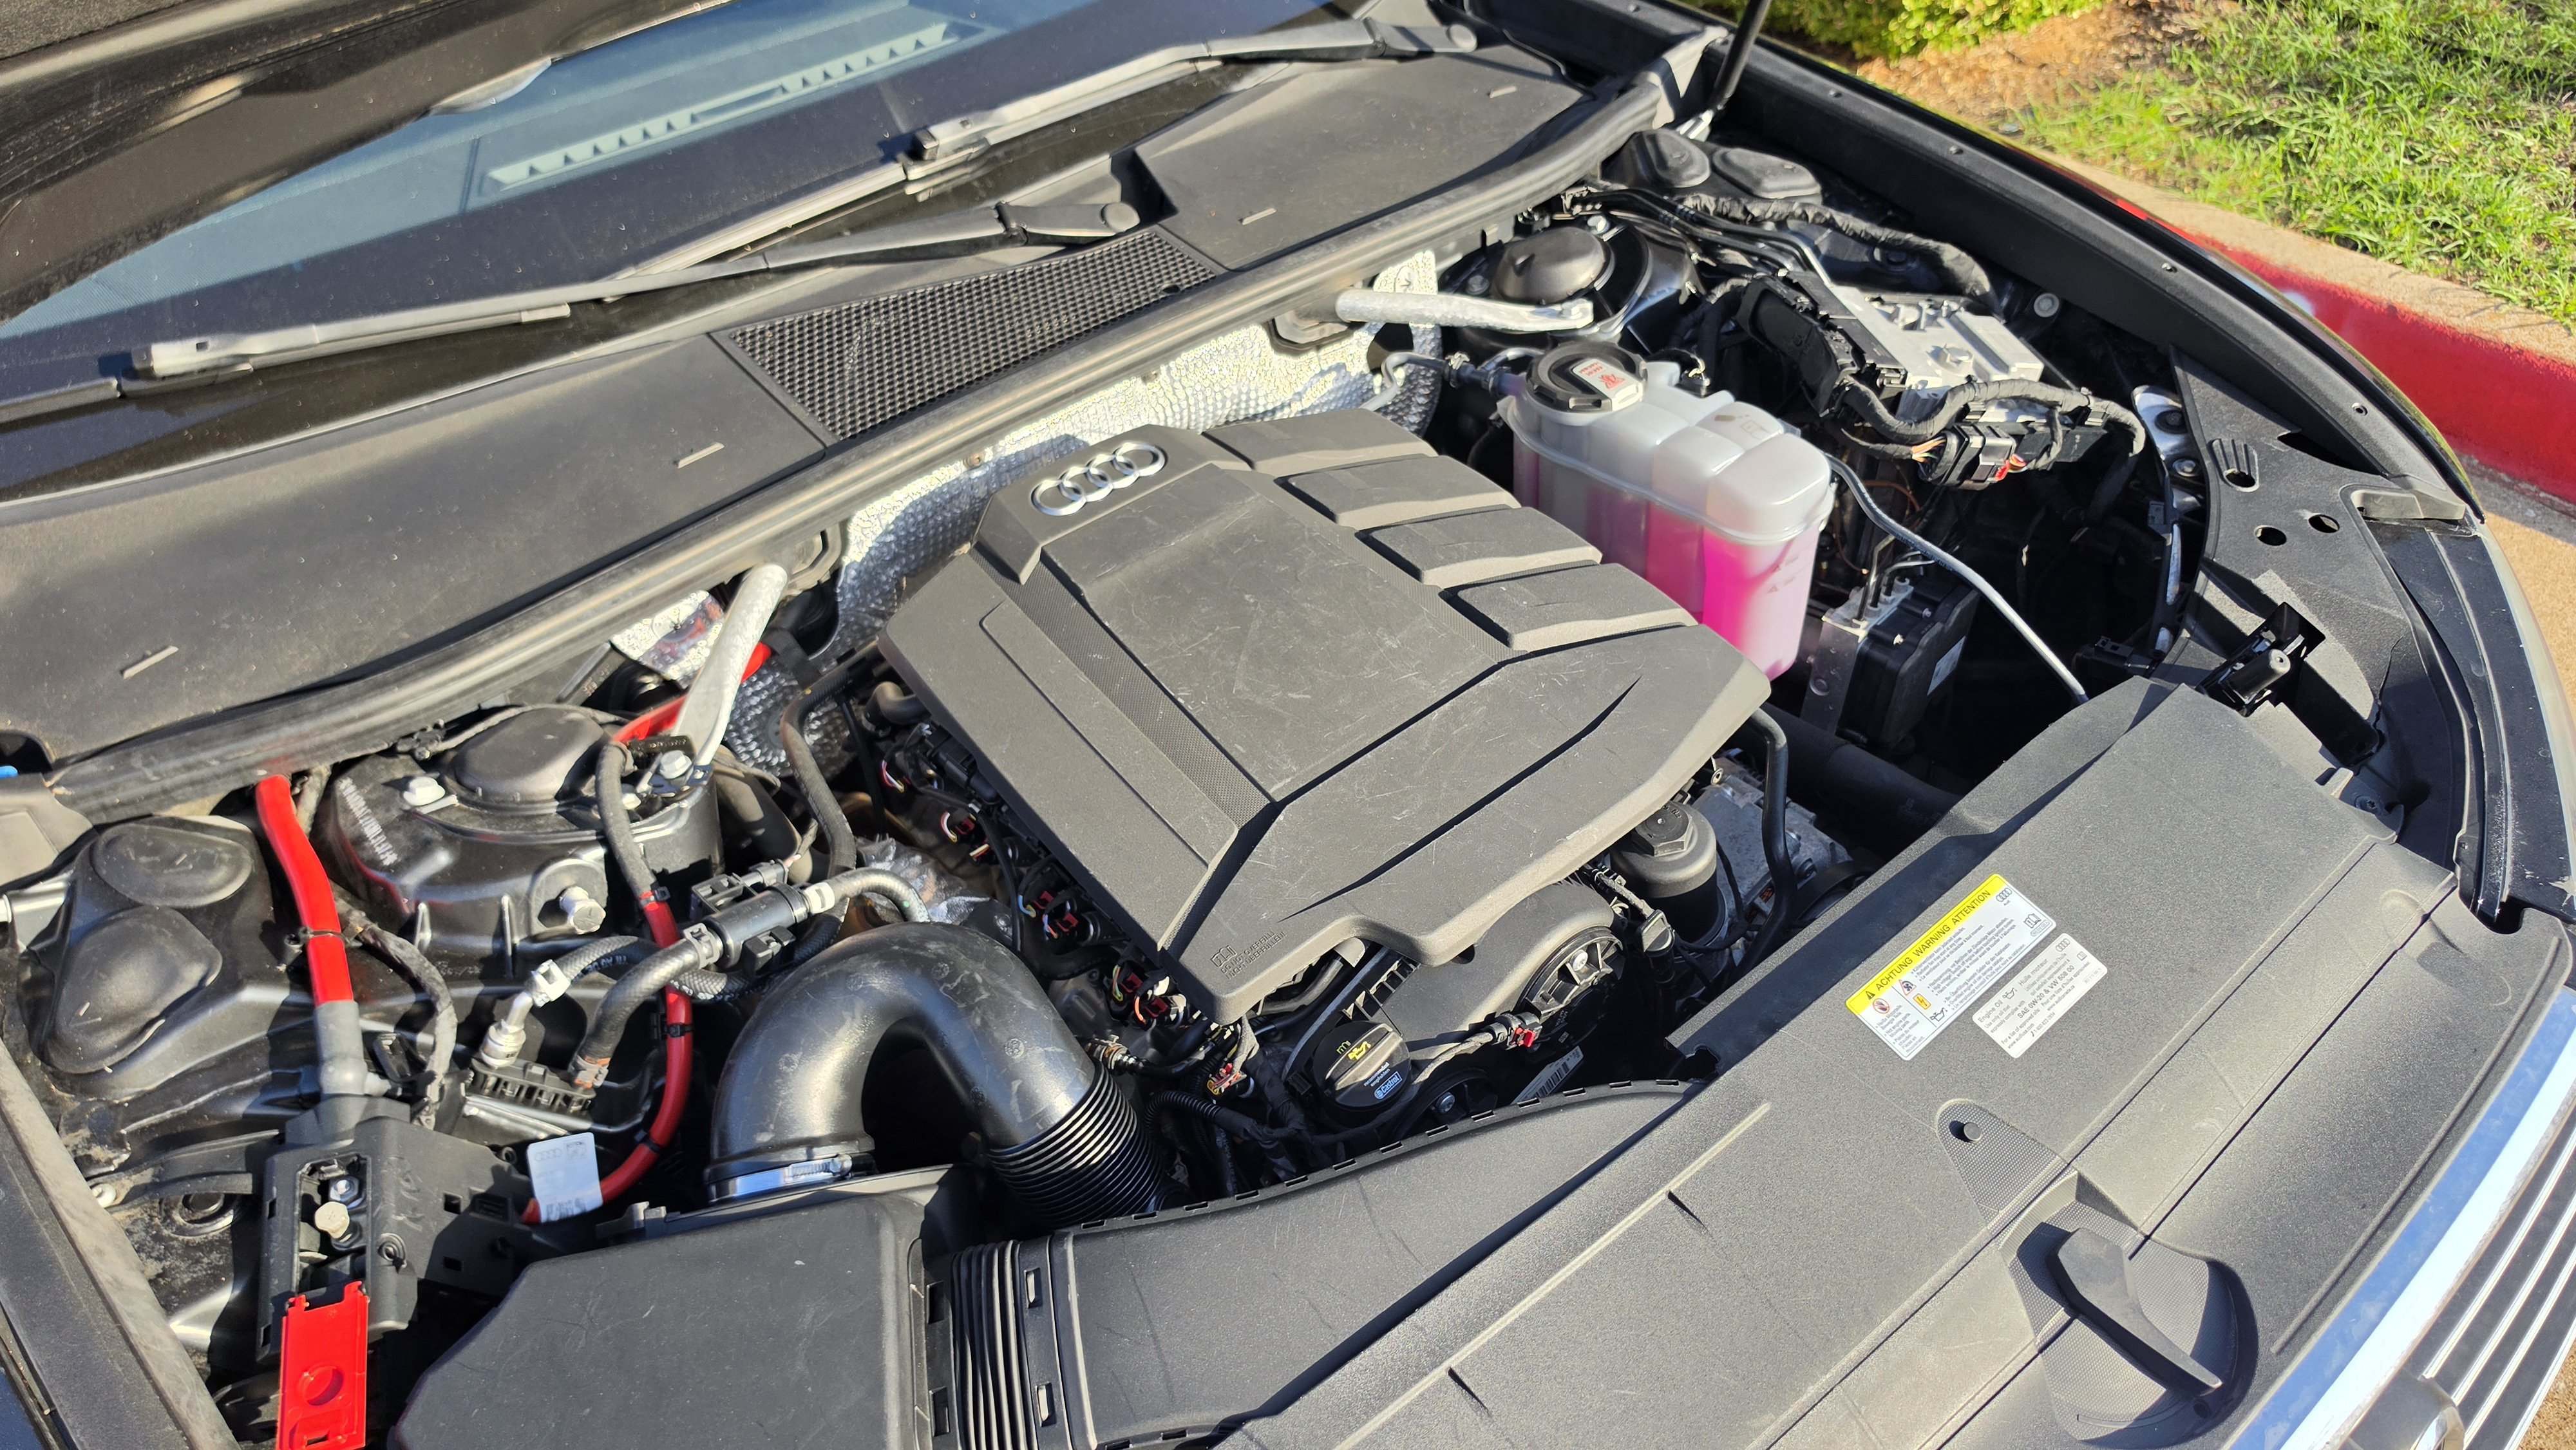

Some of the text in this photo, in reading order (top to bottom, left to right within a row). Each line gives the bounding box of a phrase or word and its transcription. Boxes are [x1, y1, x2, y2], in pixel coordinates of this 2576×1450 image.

[1876, 890, 1991, 991] ACHTUNG WARNING ATTENTION
[1969, 957, 1979, 966] moteur
[2018, 959, 2048, 986] Huile moteur
[2017, 1006, 2030, 1018] SAE
[2028, 993, 2045, 1008] 0W-20
[2048, 979, 2058, 989] VW
[2057, 971, 2068, 981] 508
[1978, 999, 2003, 1022] Engine Oil
[1908, 1019, 1920, 1030] moteur
[1363, 1062, 1390, 1087] recommended
[1370, 1068, 1390, 1087] empfohlen
[1381, 1075, 1400, 1093] Castrol
